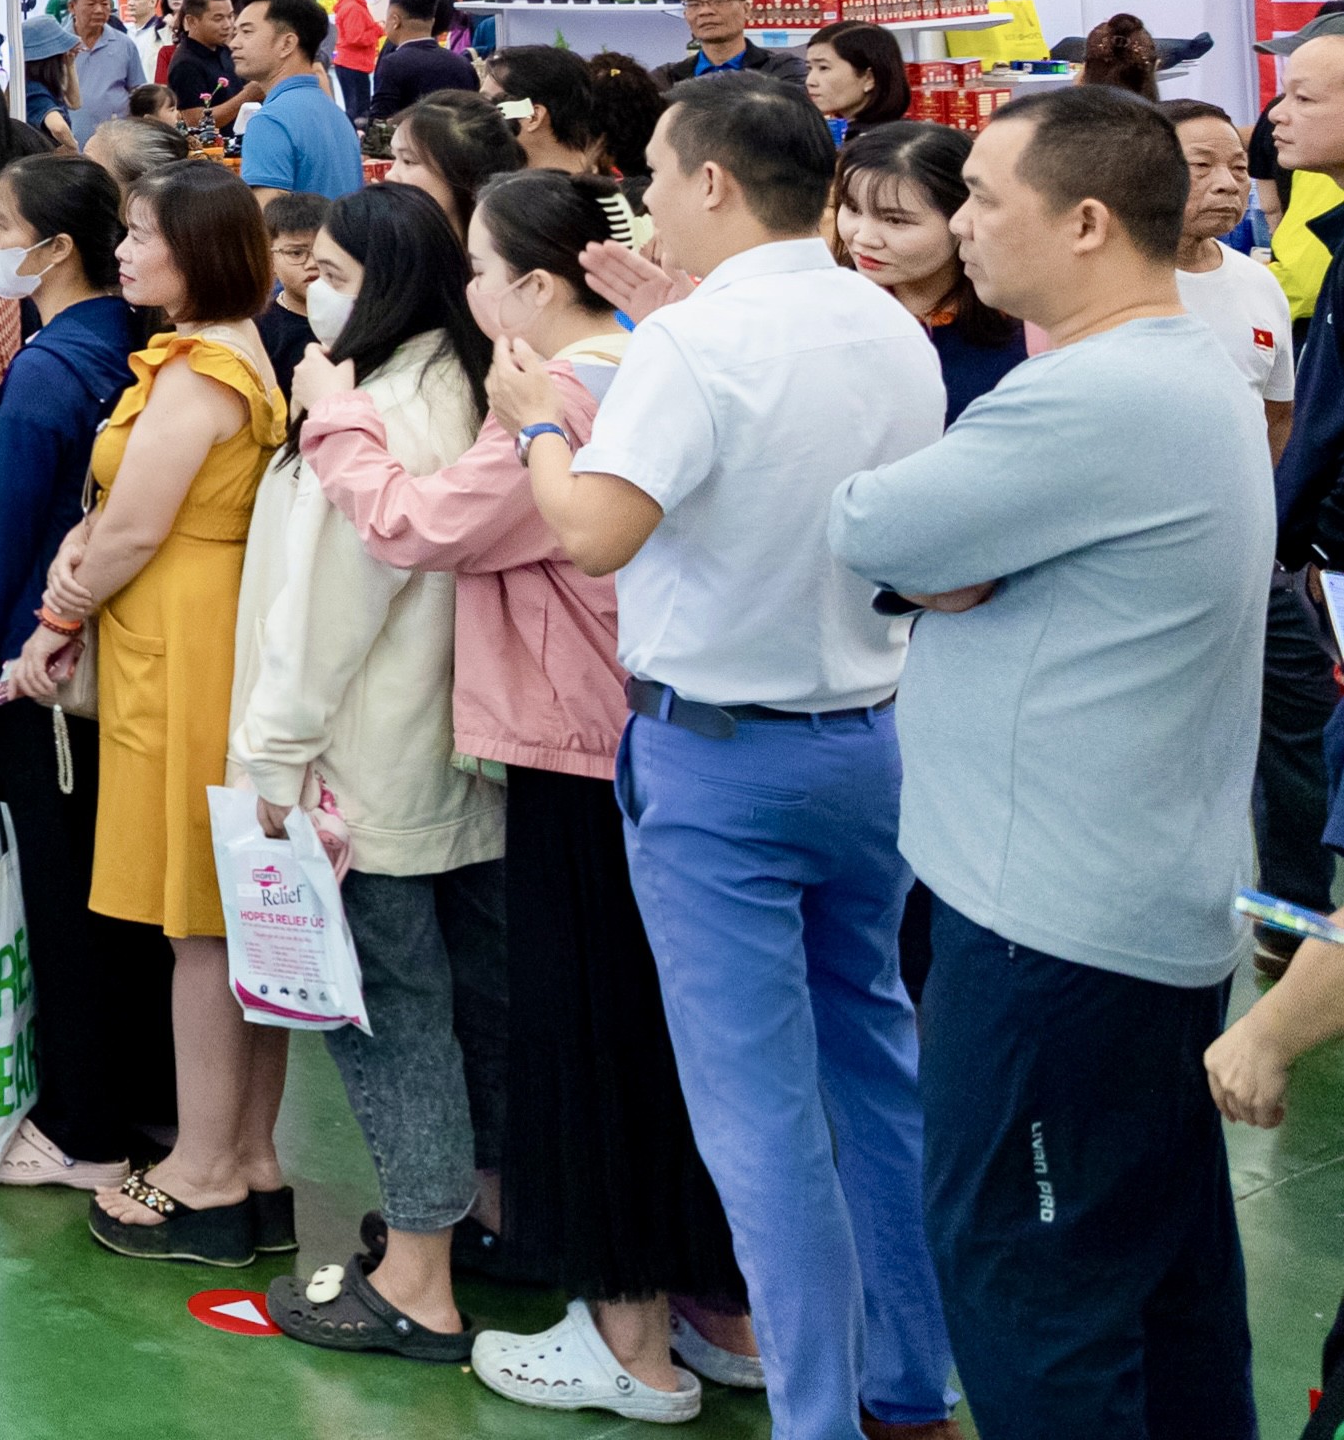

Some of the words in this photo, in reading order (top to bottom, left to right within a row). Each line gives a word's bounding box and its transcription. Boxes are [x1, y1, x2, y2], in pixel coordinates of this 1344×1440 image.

[255, 872, 278, 882] HOPE'S
[261, 885, 302, 906] Relief
[240, 910, 275, 923] HOPE'S
[275, 913, 308, 926] RELIEF
